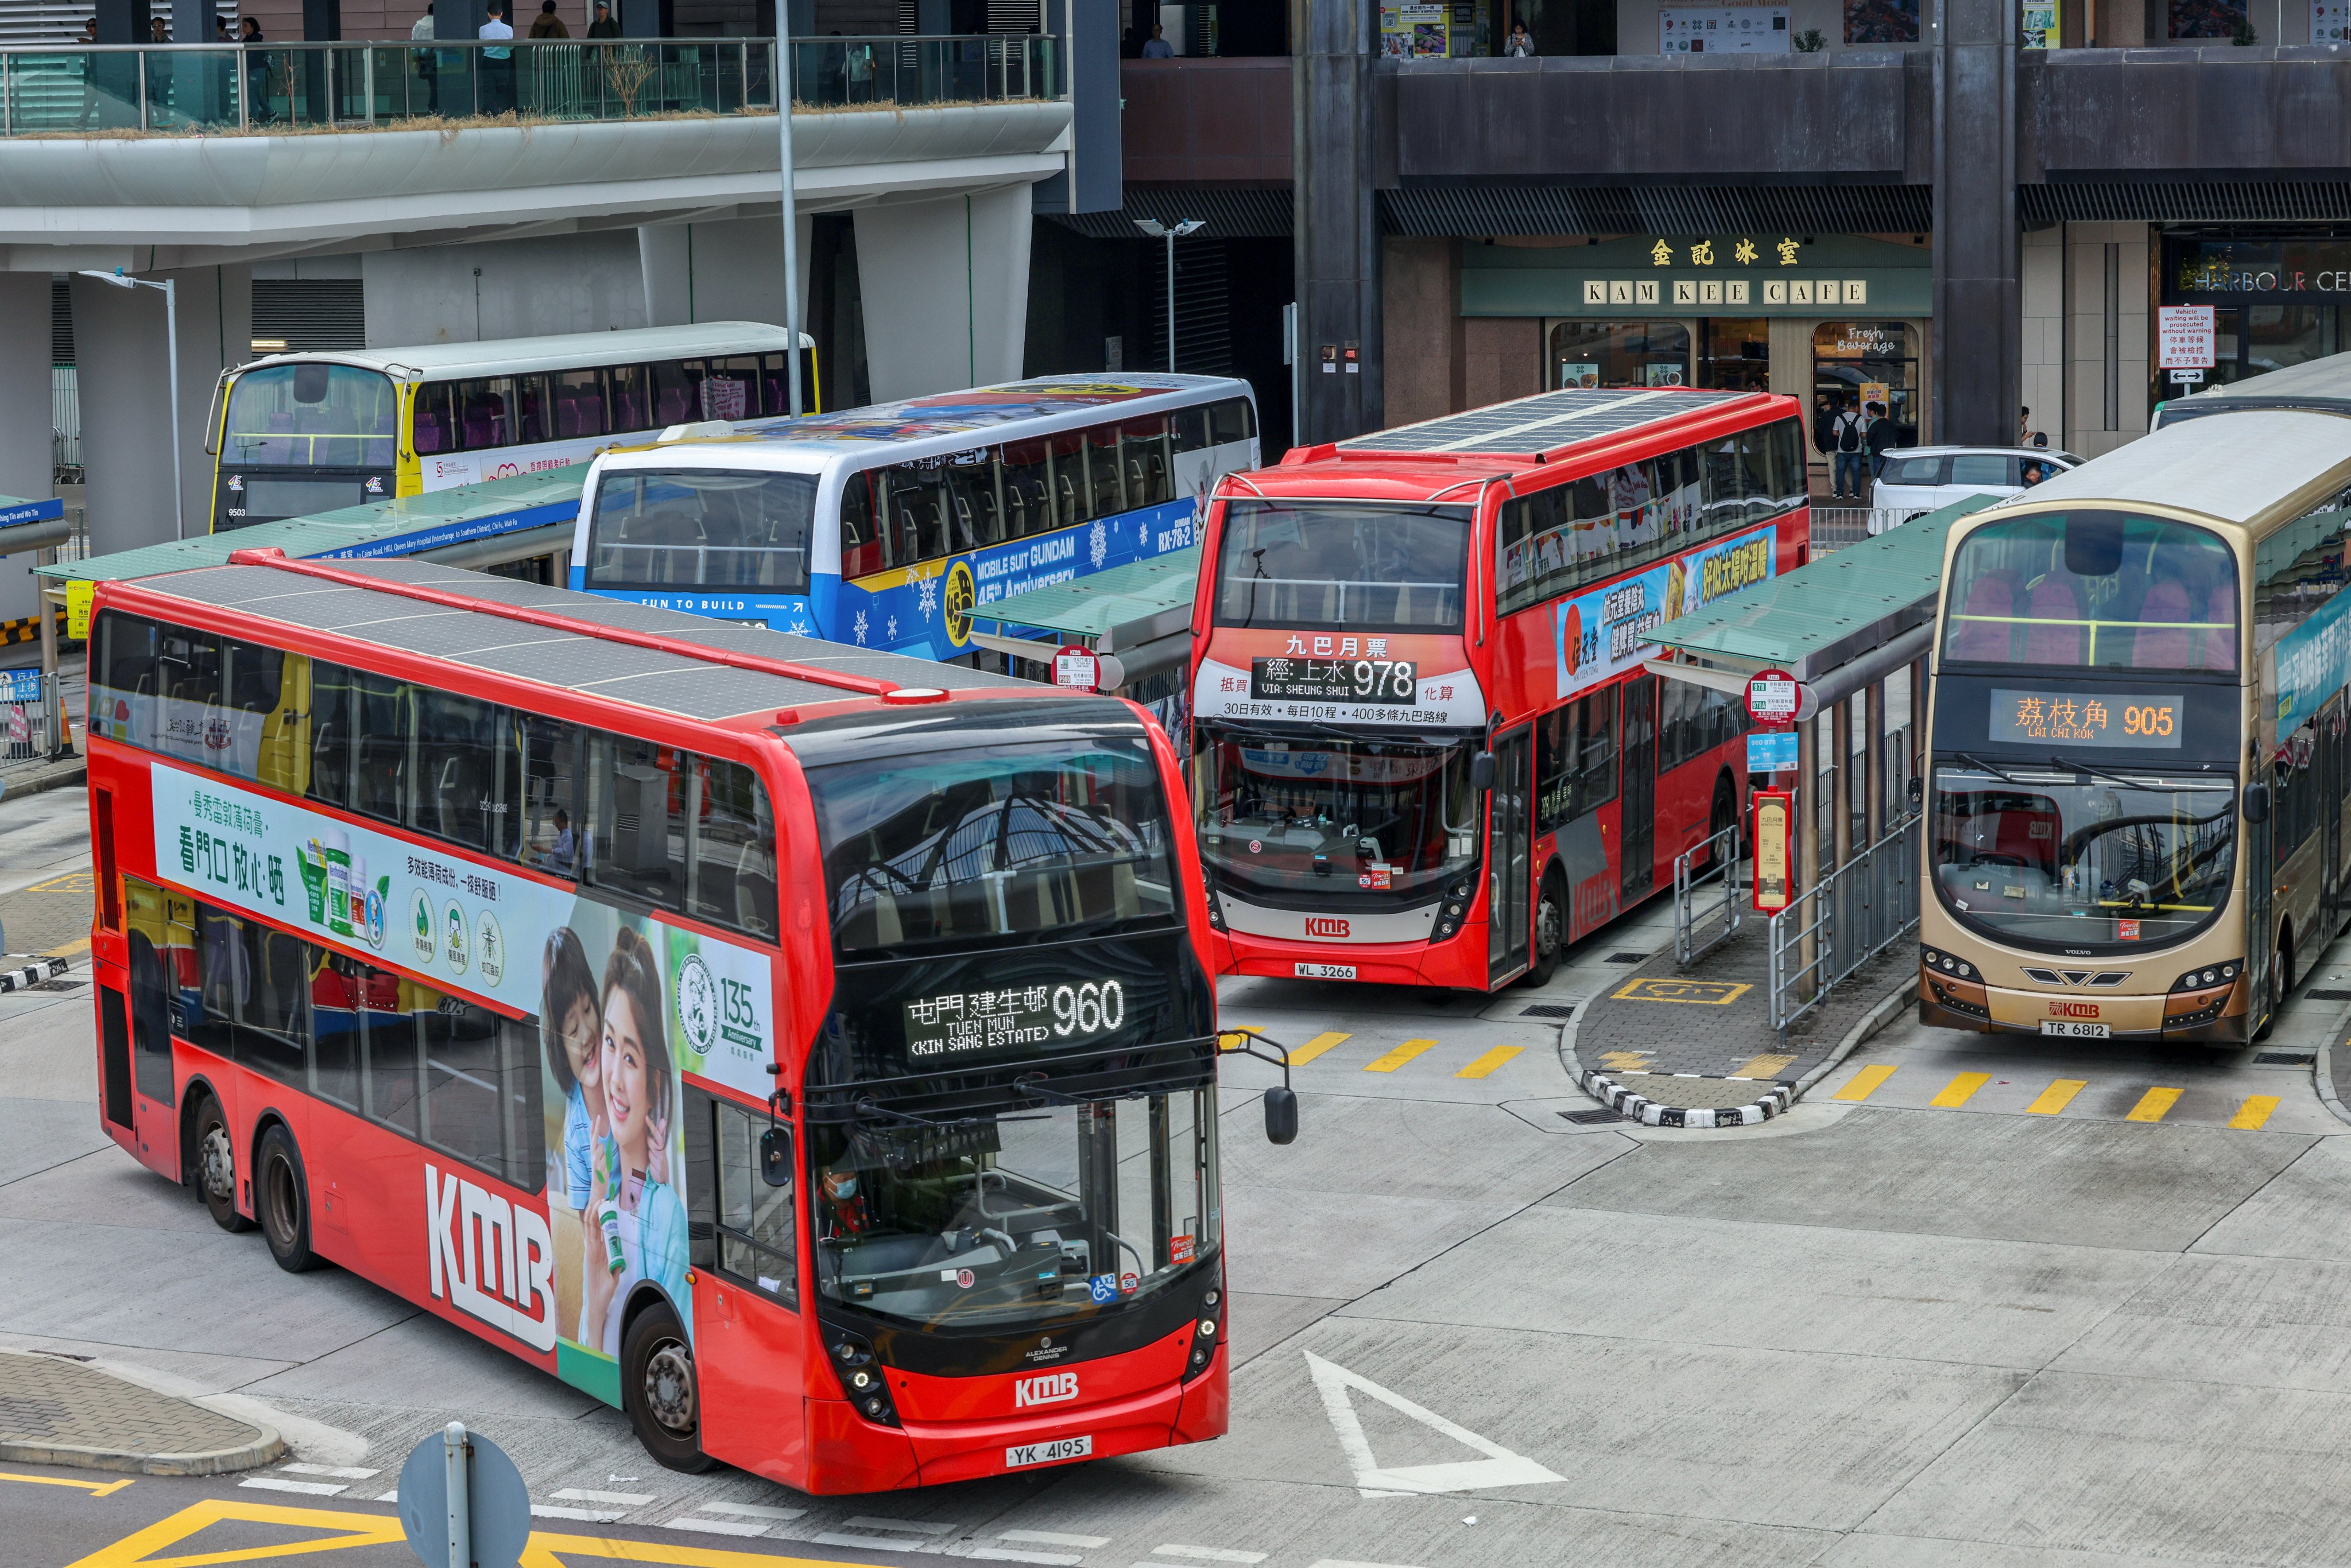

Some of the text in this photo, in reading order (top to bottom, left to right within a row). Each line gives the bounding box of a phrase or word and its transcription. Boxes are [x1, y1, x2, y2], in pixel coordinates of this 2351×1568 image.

[1651, 237, 1800, 266] 金記冰室
[2195, 271, 2351, 292] HARBOUR CE
[1589, 284, 1860, 300] KAM KEE CAFE
[1849, 327, 1883, 341] Fresh
[2170, 336, 2204, 344] 停車等候
[1838, 340, 1895, 354] Beverage
[2170, 346, 2205, 354] 會被檢控
[2166, 356, 2209, 364] 而不予警告
[25, 510, 31, 518] Wo
[228, 509, 246, 517] 9503
[1174, 517, 1190, 527] GUNDAM
[361, 549, 372, 558] Caine
[373, 547, 383, 557] Road,
[384, 545, 393, 553] HKU,
[394, 543, 406, 553] Queen
[406, 540, 416, 551] Mary
[416, 535, 431, 549] Hospital
[432, 533, 455, 545] (Interchange
[460, 527, 477, 537] Southern
[477, 525, 491, 535] District),
[1159, 526, 1190, 553] RX-78-2
[977, 536, 1074, 581] MOBILE SUIT GUNDAM
[1702, 535, 1768, 601] 好似太陽咁溫暖
[978, 569, 1074, 606] 45th Anniversary
[642, 599, 744, 610] FUN TO BUILD
[1602, 581, 1645, 625] 位元堂養陰丸
[951, 624, 956, 633] TH
[1286, 635, 1388, 658] 九巴月票
[1610, 620, 1636, 662] 健脾胃
[1300, 659, 1345, 683] 上水
[1353, 660, 1412, 697] 978
[1580, 669, 1589, 681] YUEN
[1589, 664, 1598, 678] TONG
[1220, 676, 1248, 693] 抵買
[1262, 683, 1349, 696] VIA: SHEUNG SHUI
[1424, 686, 1454, 701] 化算
[1224, 703, 1448, 724] 30日有效 每日10程 400多條九巴路線
[2015, 697, 2107, 729] 荔枝角
[2124, 707, 2173, 736] 905
[2028, 727, 2094, 739] LAI CHI KOK
[193, 790, 262, 838] 曼秀雷敦薄荷膏
[1372, 871, 1389, 880] Tourist
[1305, 917, 1350, 938] KMB
[2120, 921, 2139, 929] Tourist
[1298, 964, 1353, 978] WL 3266
[908, 986, 1047, 1025] 屯門 建生邨
[1052, 980, 1124, 1036] 960
[2063, 1003, 2100, 1018] KMB
[946, 1016, 1014, 1037] TUEN MUN
[2048, 1023, 2104, 1037] TR 6812
[727, 1028, 757, 1048] Anniversary
[912, 1026, 1049, 1055] (KIN SANG ESTATE)
[1171, 1238, 1193, 1251] Tourist
[425, 1163, 556, 1352] KMB
[1173, 1248, 1194, 1262] 旅客日票
[1124, 1279, 1136, 1288] 5G
[1025, 1346, 1067, 1357] ALEXANDER
[1033, 1353, 1059, 1361] DENNIS
[1015, 1372, 1079, 1408] KMB
[1014, 1439, 1085, 1465] YK 4195
